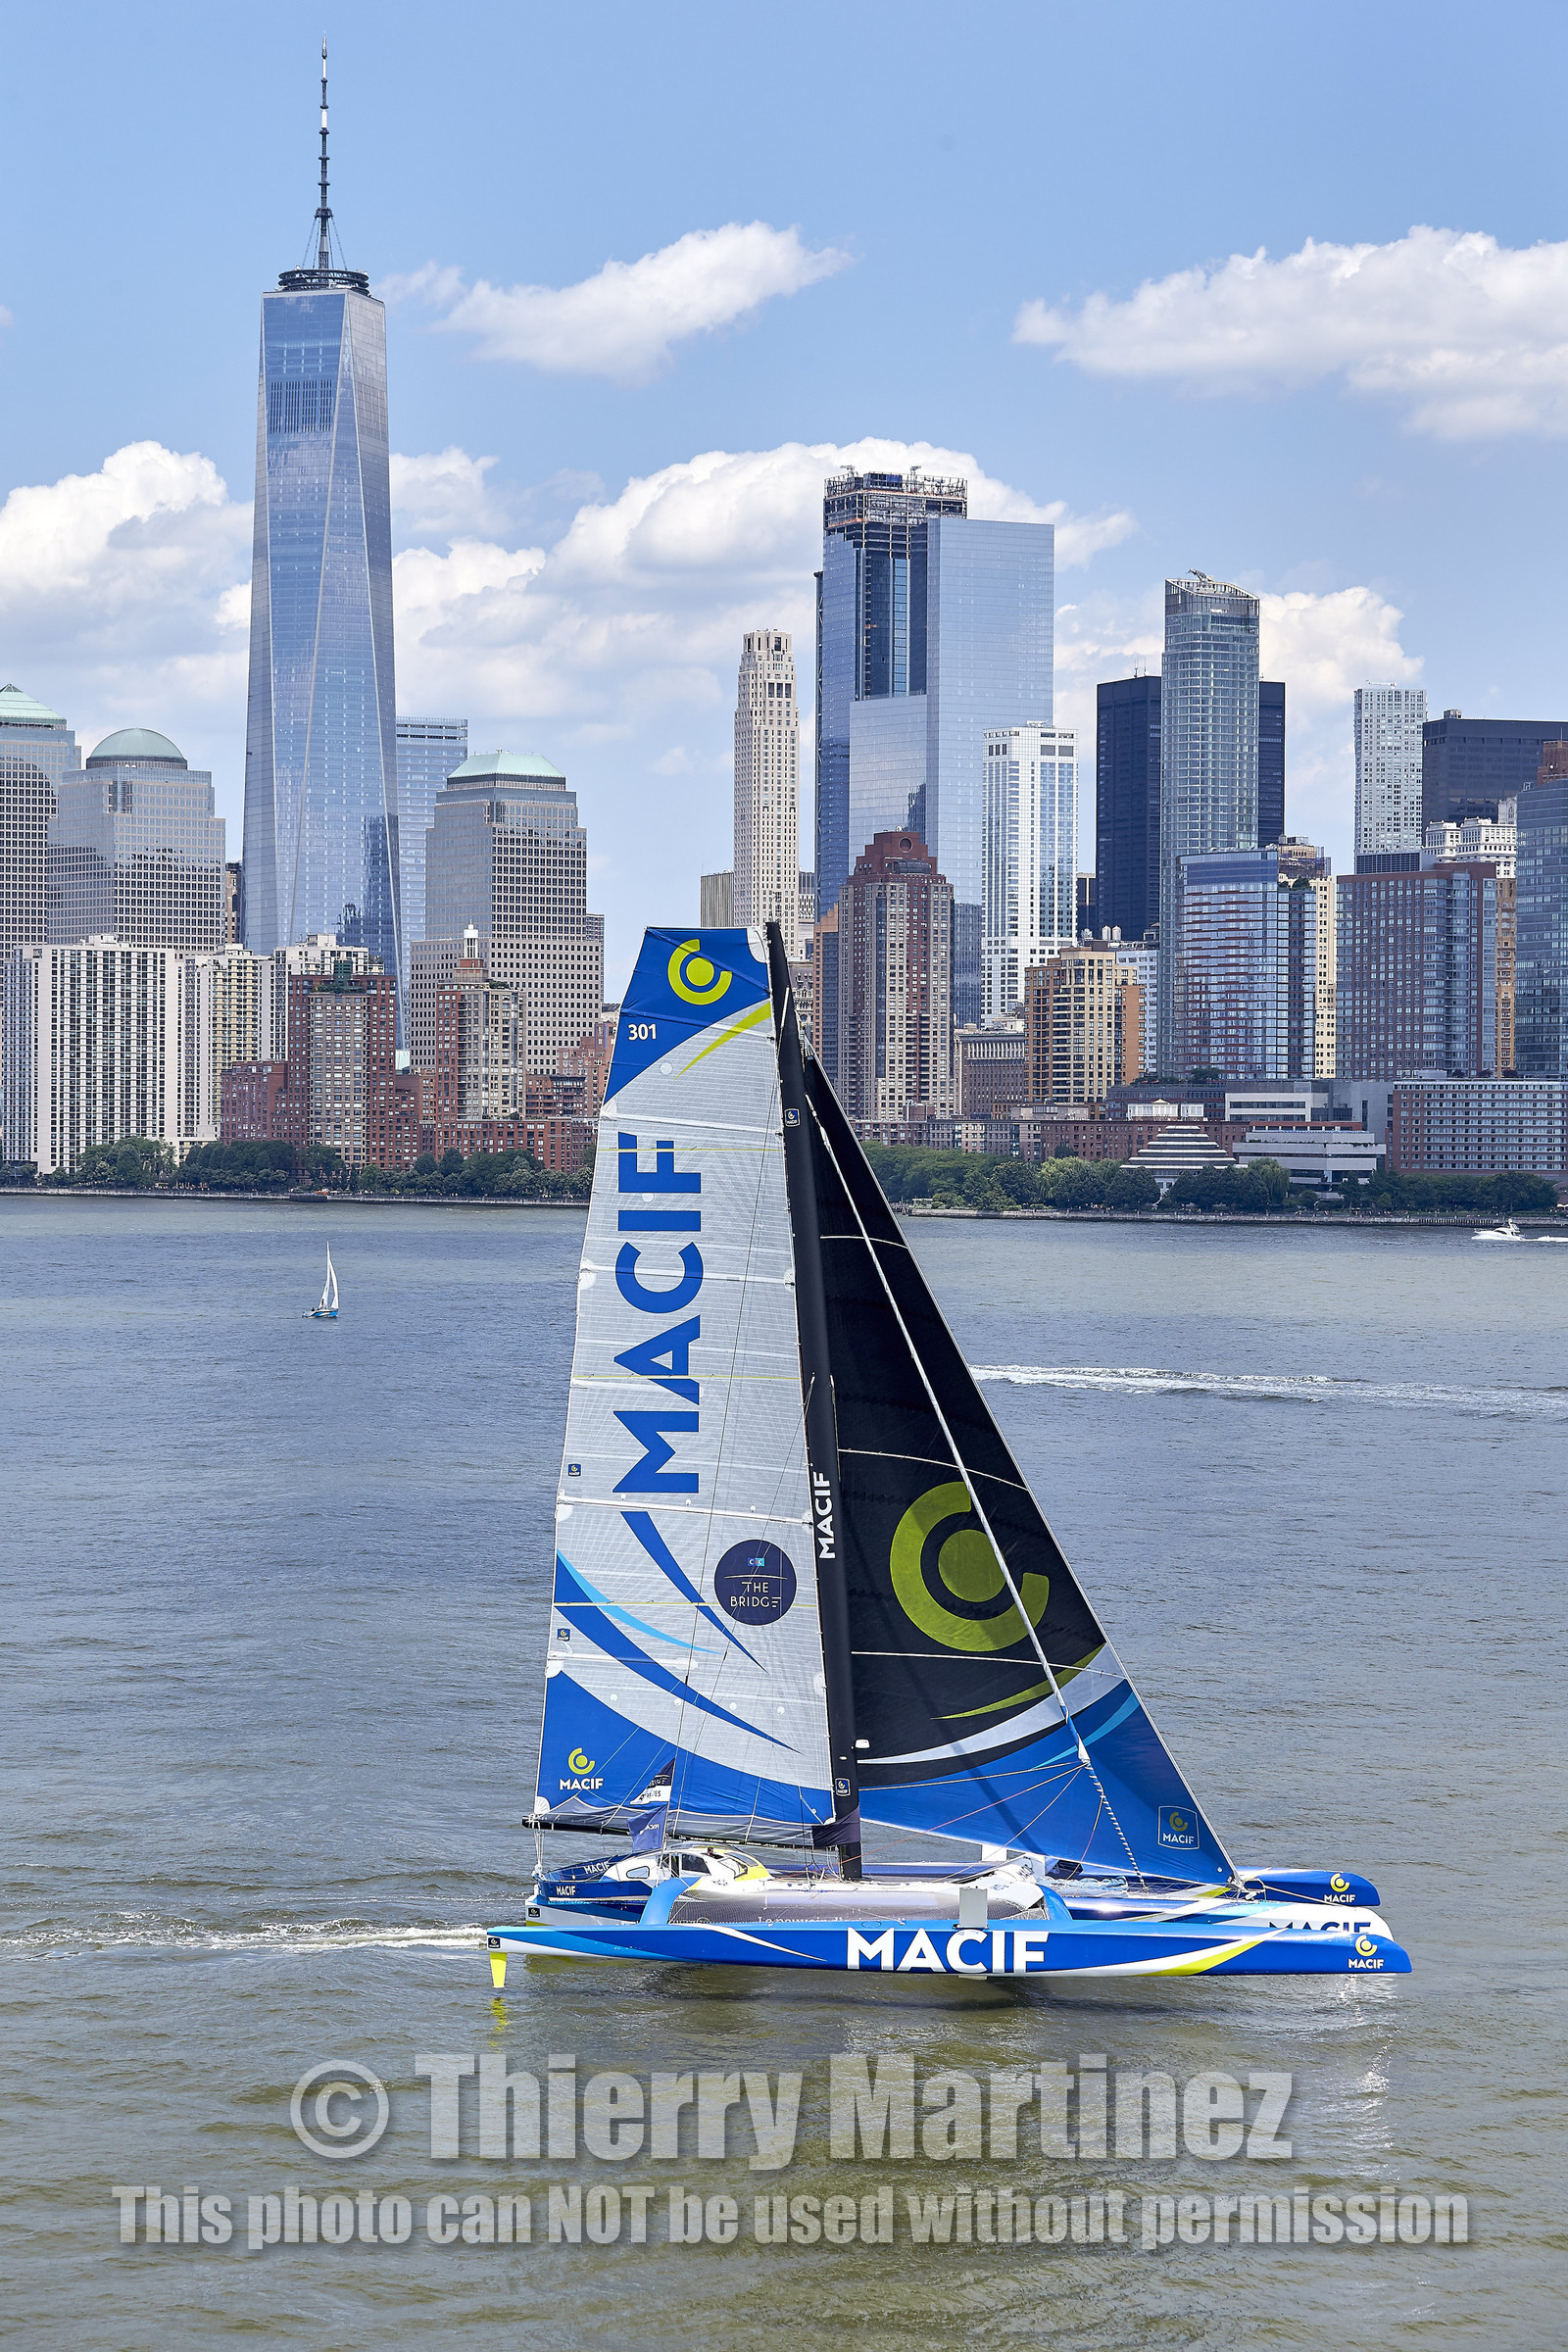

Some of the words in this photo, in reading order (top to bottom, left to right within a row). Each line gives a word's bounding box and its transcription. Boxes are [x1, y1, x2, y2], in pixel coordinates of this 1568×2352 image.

[628, 1023, 657, 1041] 301
[612, 1131, 704, 1494] MACIF
[812, 1471, 836, 1559] MACIF
[741, 1582, 769, 1593] THE
[730, 1595, 782, 1608] BRIDGE
[560, 1778, 604, 1790] MACIF
[1162, 1833, 1195, 1844] MACIF
[583, 1860, 612, 1875] MACIF
[556, 1885, 576, 1896] MACIF
[1323, 1893, 1356, 1903] MACIF
[847, 1927, 1050, 1974] MACIF
[1348, 1958, 1385, 1969] MACIF
